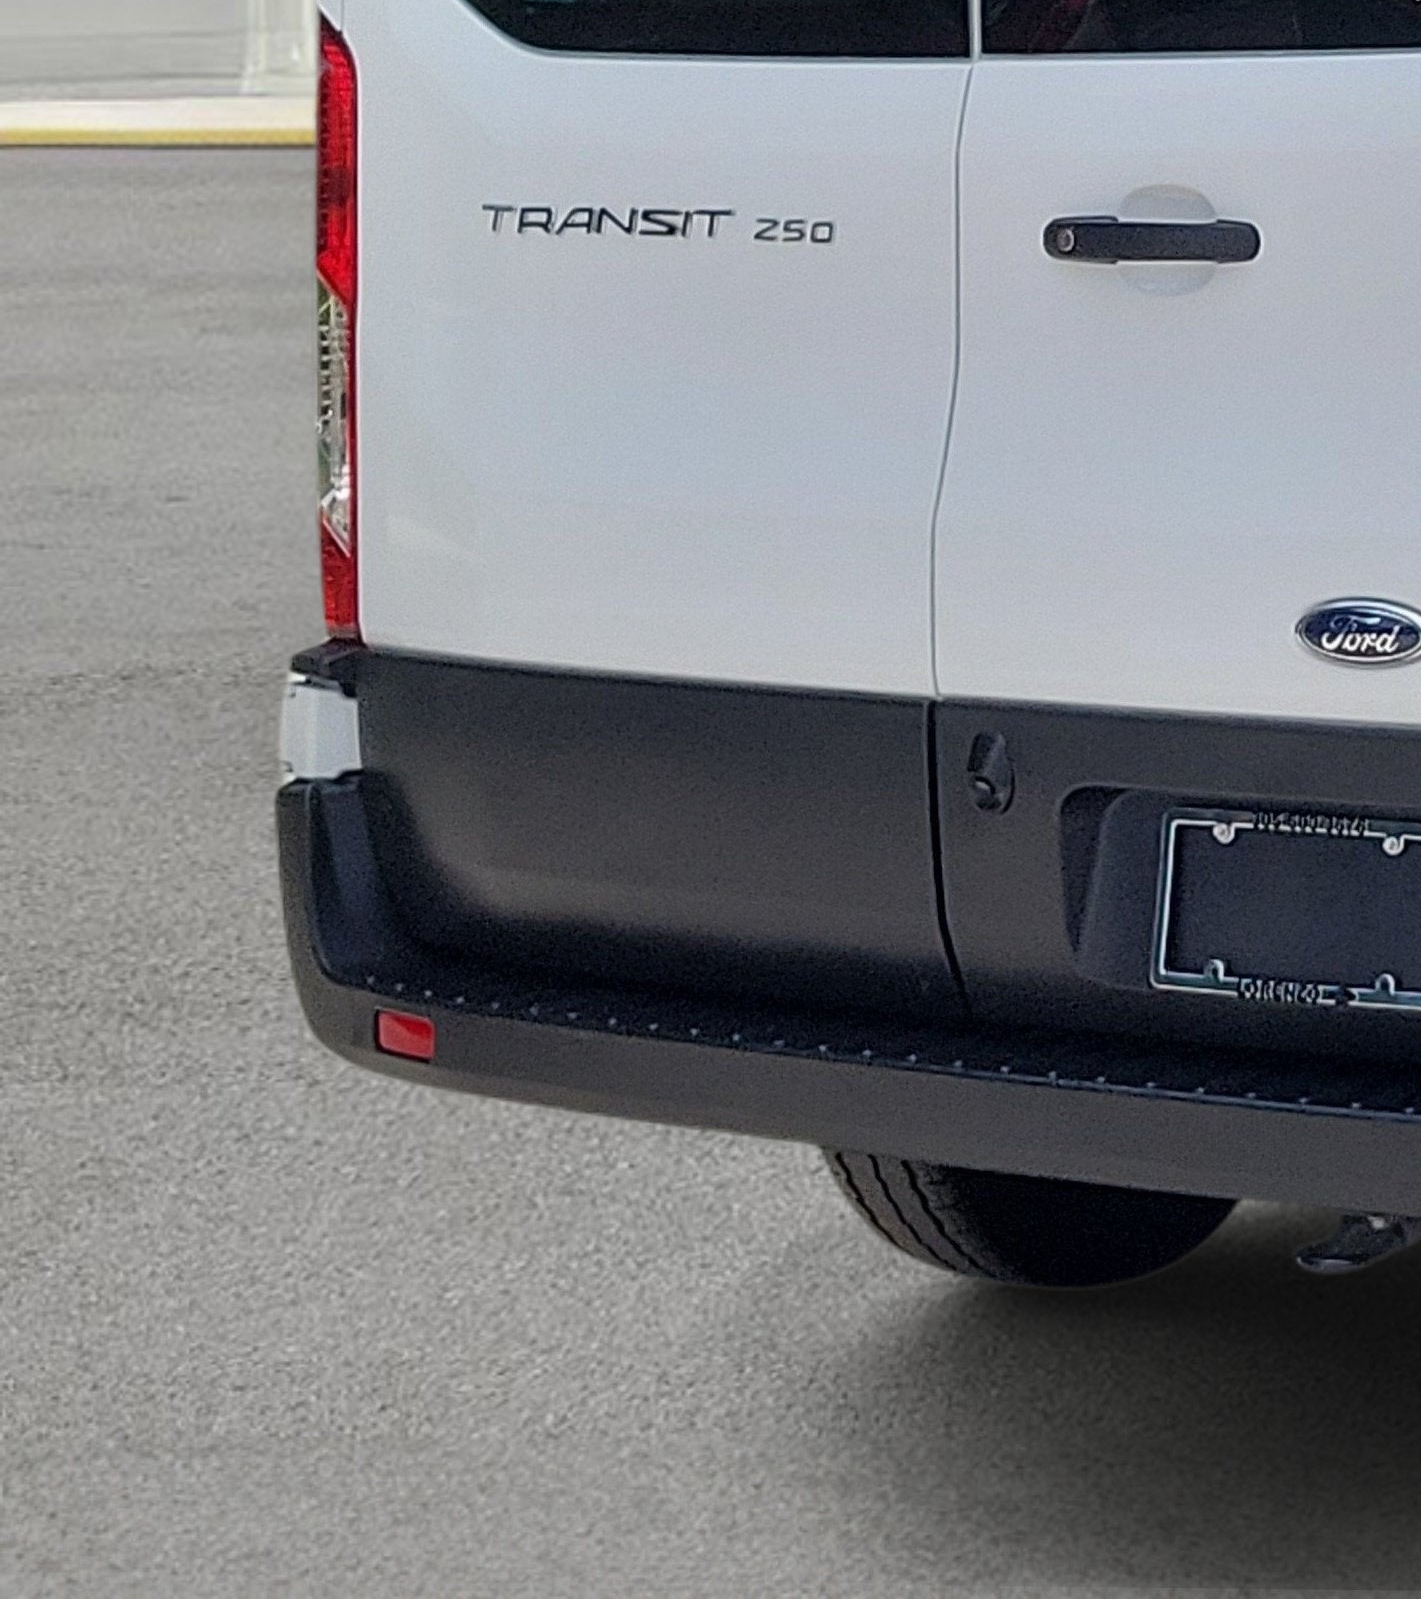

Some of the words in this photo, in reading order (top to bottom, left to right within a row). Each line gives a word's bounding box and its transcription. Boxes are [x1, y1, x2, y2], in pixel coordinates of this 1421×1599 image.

[482, 203, 736, 240] TRANSIT
[753, 217, 835, 245] 250
[1321, 614, 1401, 654] Ford
